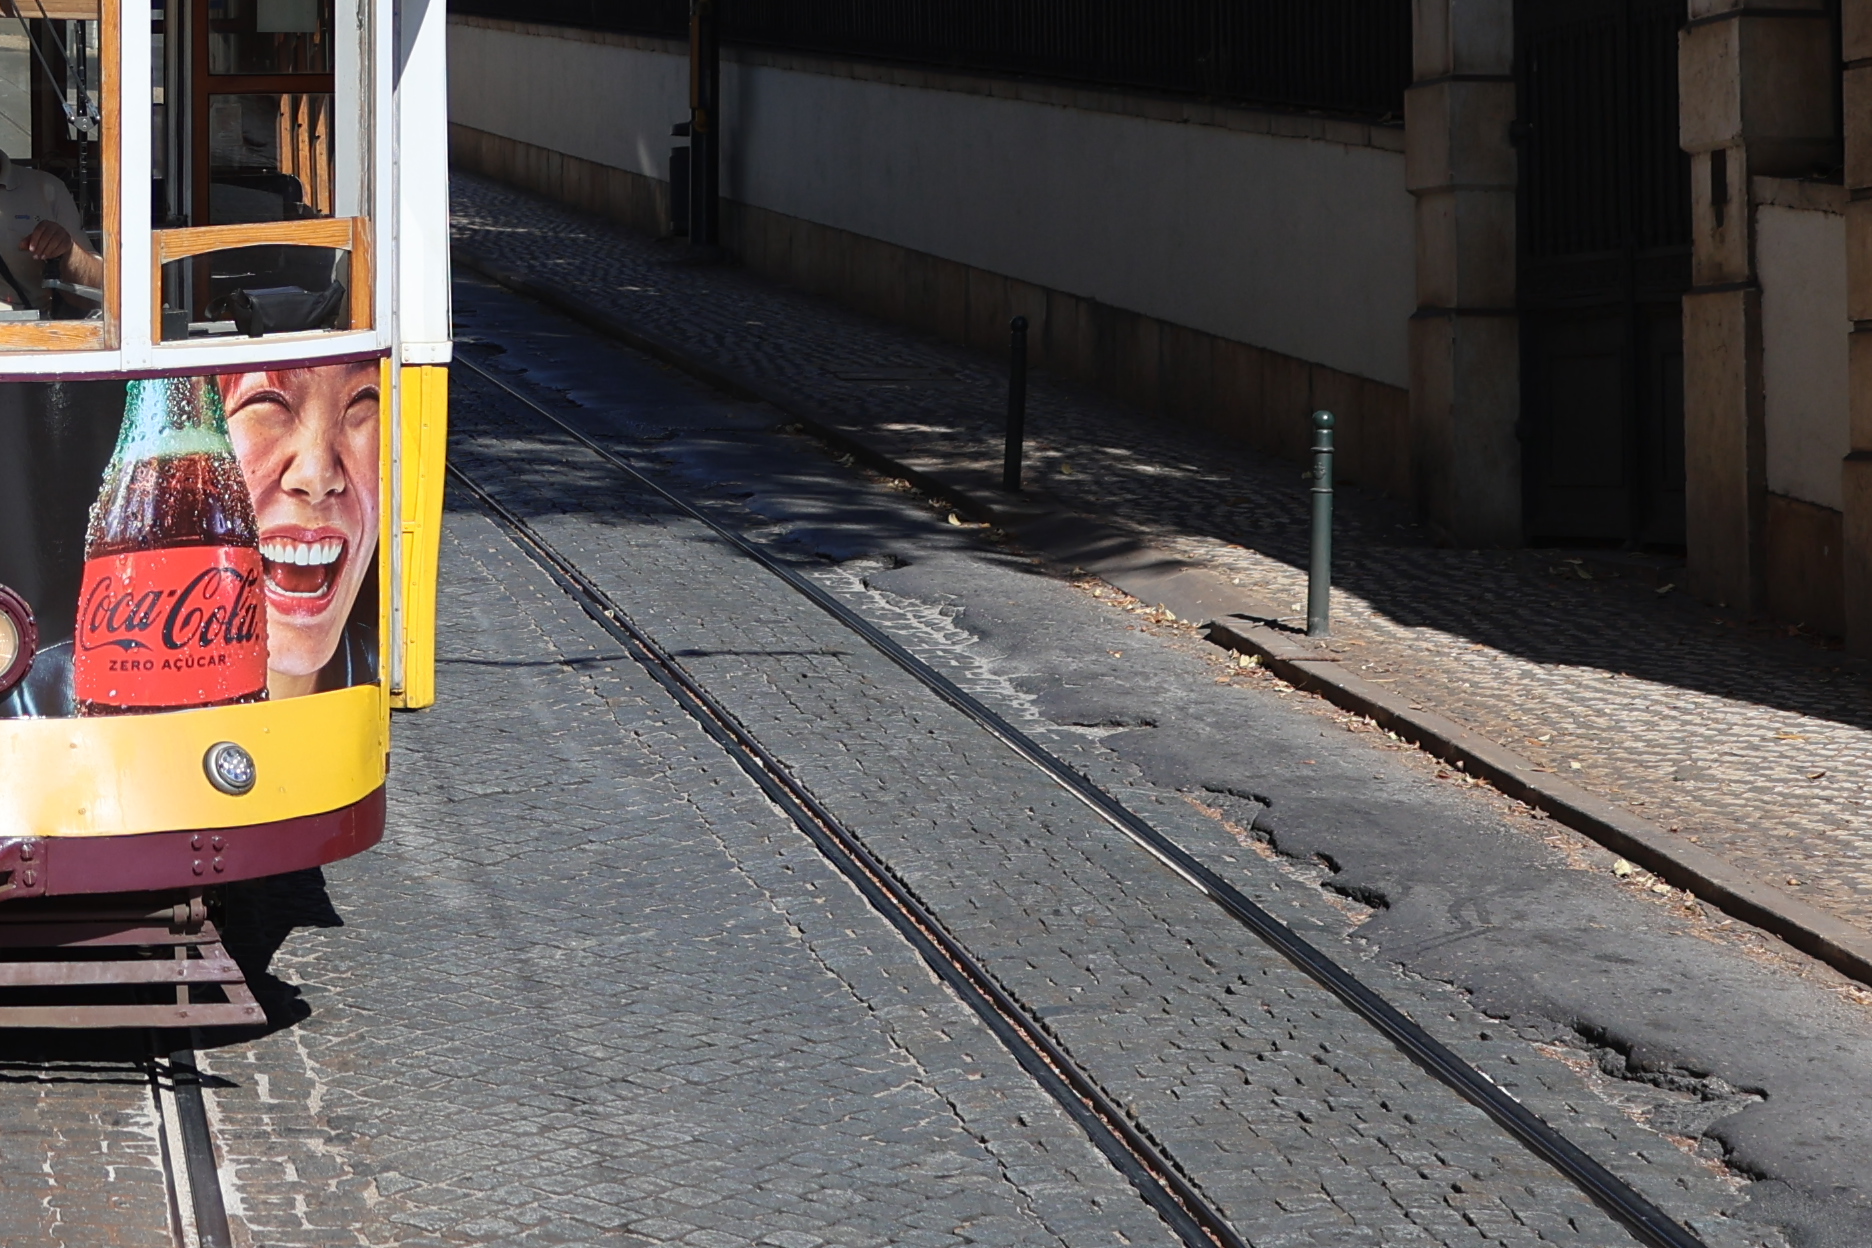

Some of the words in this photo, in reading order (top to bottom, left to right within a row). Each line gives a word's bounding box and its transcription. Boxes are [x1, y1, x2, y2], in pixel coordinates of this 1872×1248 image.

[79, 566, 260, 651] Coca-Cola
[109, 658, 155, 672] ZERO
[161, 653, 227, 672] AÇÚCAR
